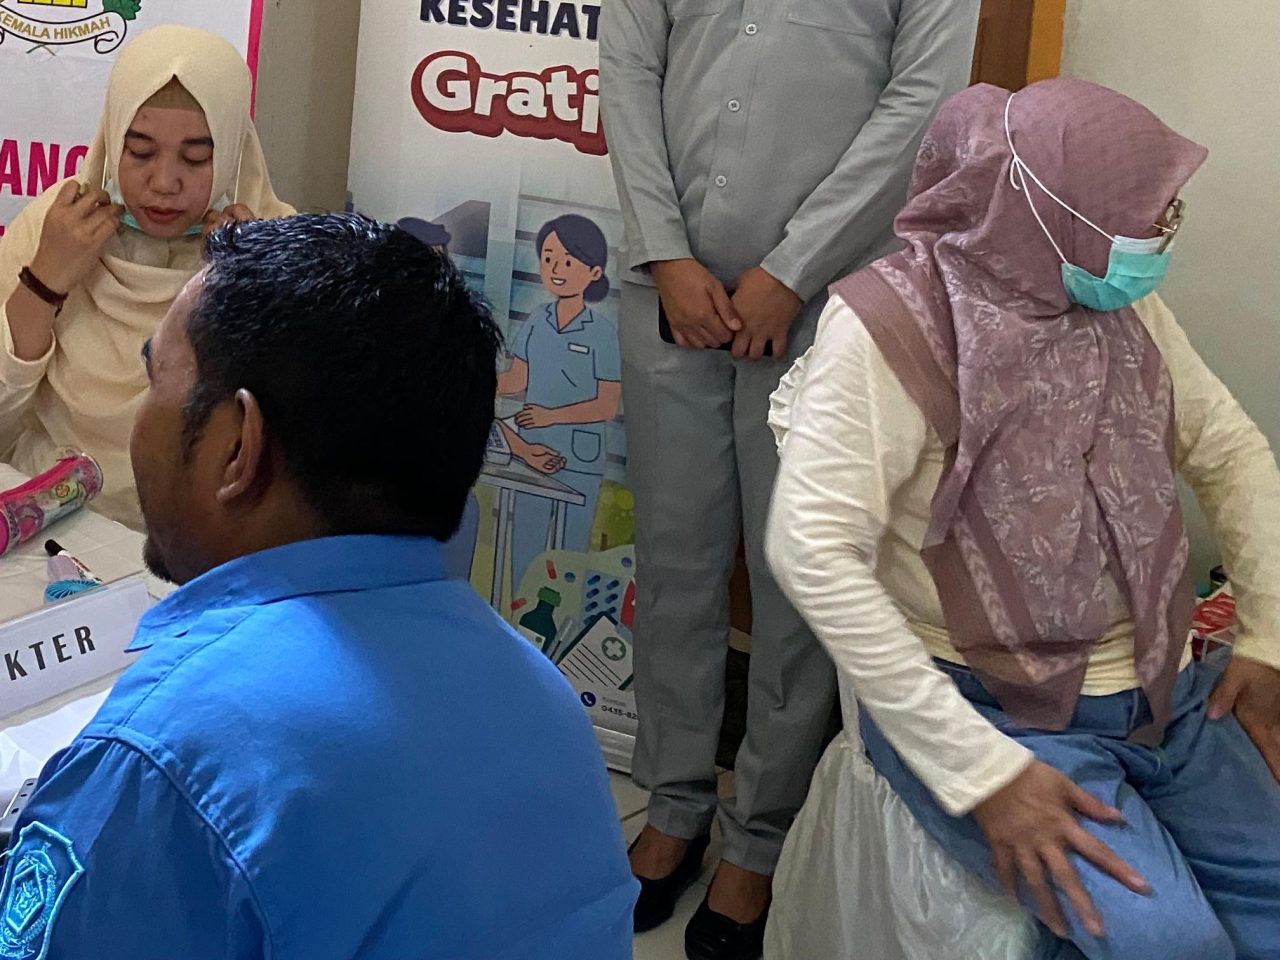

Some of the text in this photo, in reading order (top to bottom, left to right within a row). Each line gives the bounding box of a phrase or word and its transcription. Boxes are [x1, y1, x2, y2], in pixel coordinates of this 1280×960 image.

[54, 16, 111, 40] HIKMAH
[421, 55, 600, 134] Grati
[601, 705, 640, 721] 0435-82
